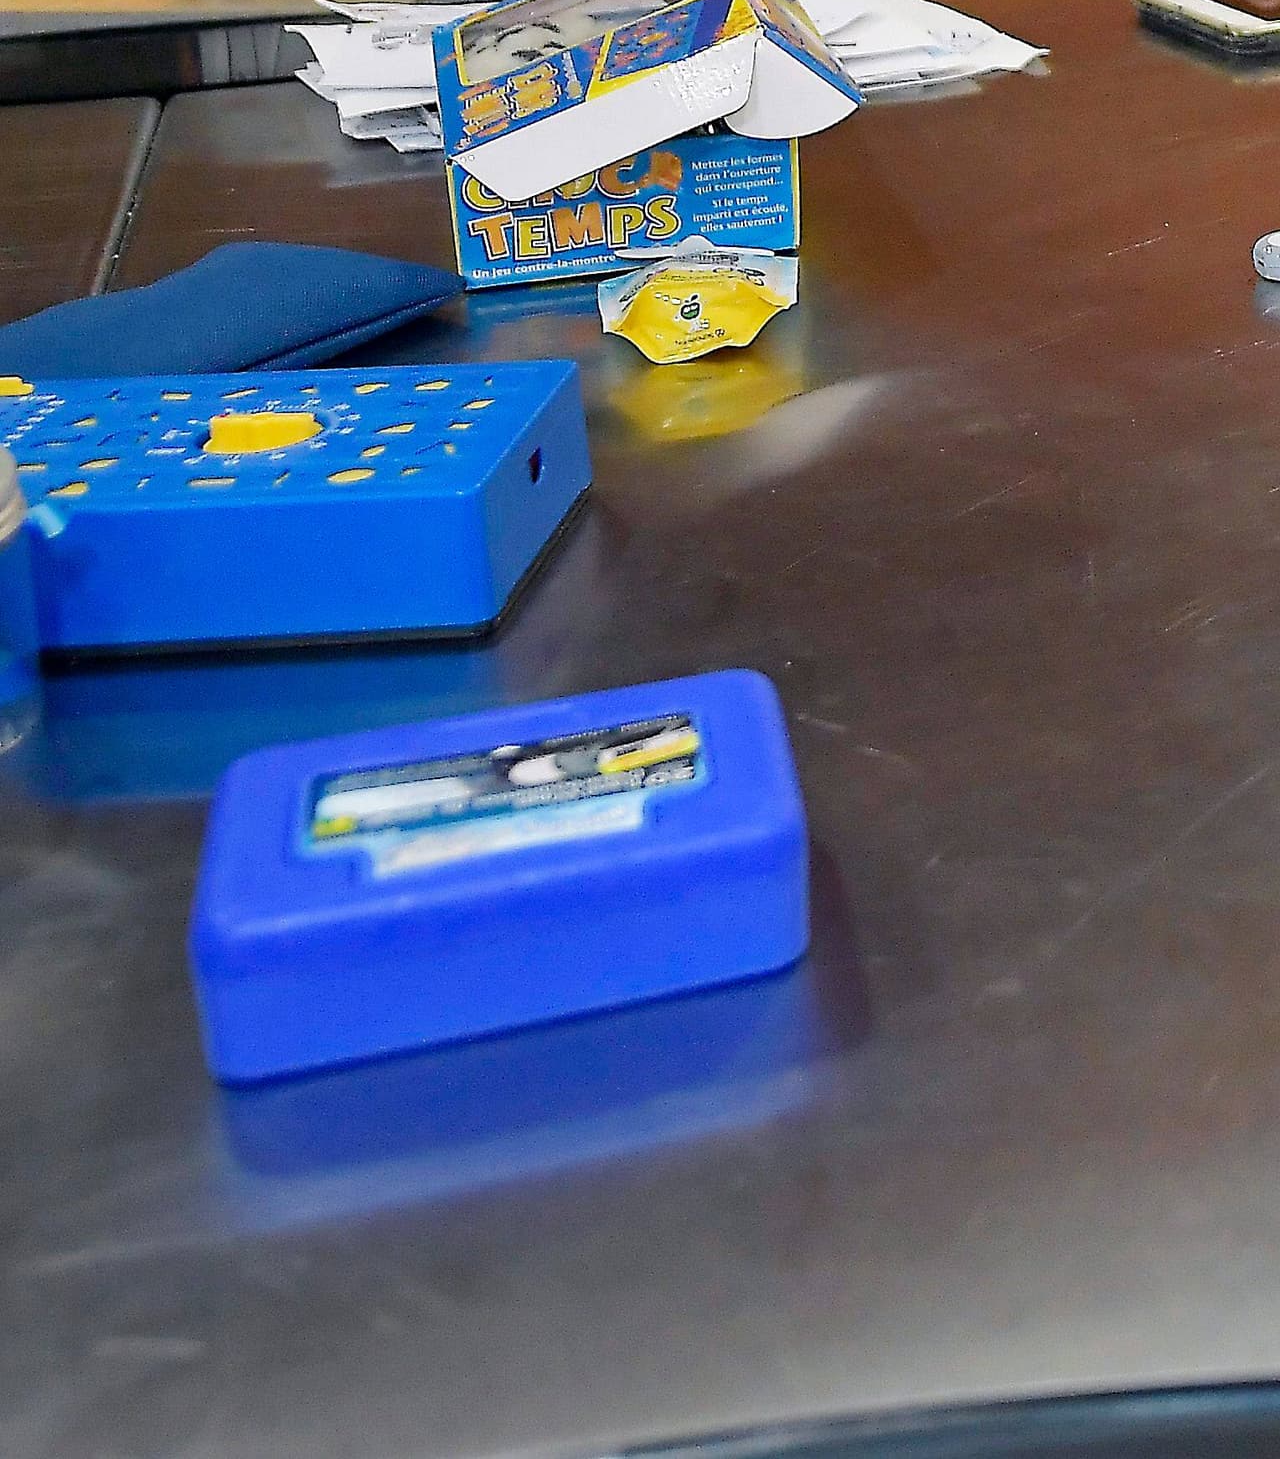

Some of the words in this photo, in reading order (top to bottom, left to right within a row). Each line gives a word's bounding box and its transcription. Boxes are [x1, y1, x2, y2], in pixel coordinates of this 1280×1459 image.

[730, 157, 745, 166] les
[747, 153, 784, 166] formes
[695, 170, 721, 182] dans
[723, 164, 782, 179] l'ouverture
[694, 183, 712, 196] qui
[714, 176, 784, 191] correspond...
[724, 197, 734, 207] le
[736, 195, 769, 206] temps
[693, 208, 732, 223] imparti
[734, 207, 750, 217] est
[468, 195, 683, 262] TEMPS
[700, 222, 724, 233] elles
[726, 217, 777, 230] sauteront
[472, 269, 490, 280] Un
[492, 267, 512, 278] jeu
[515, 254, 617, 274] contre-la-montre
